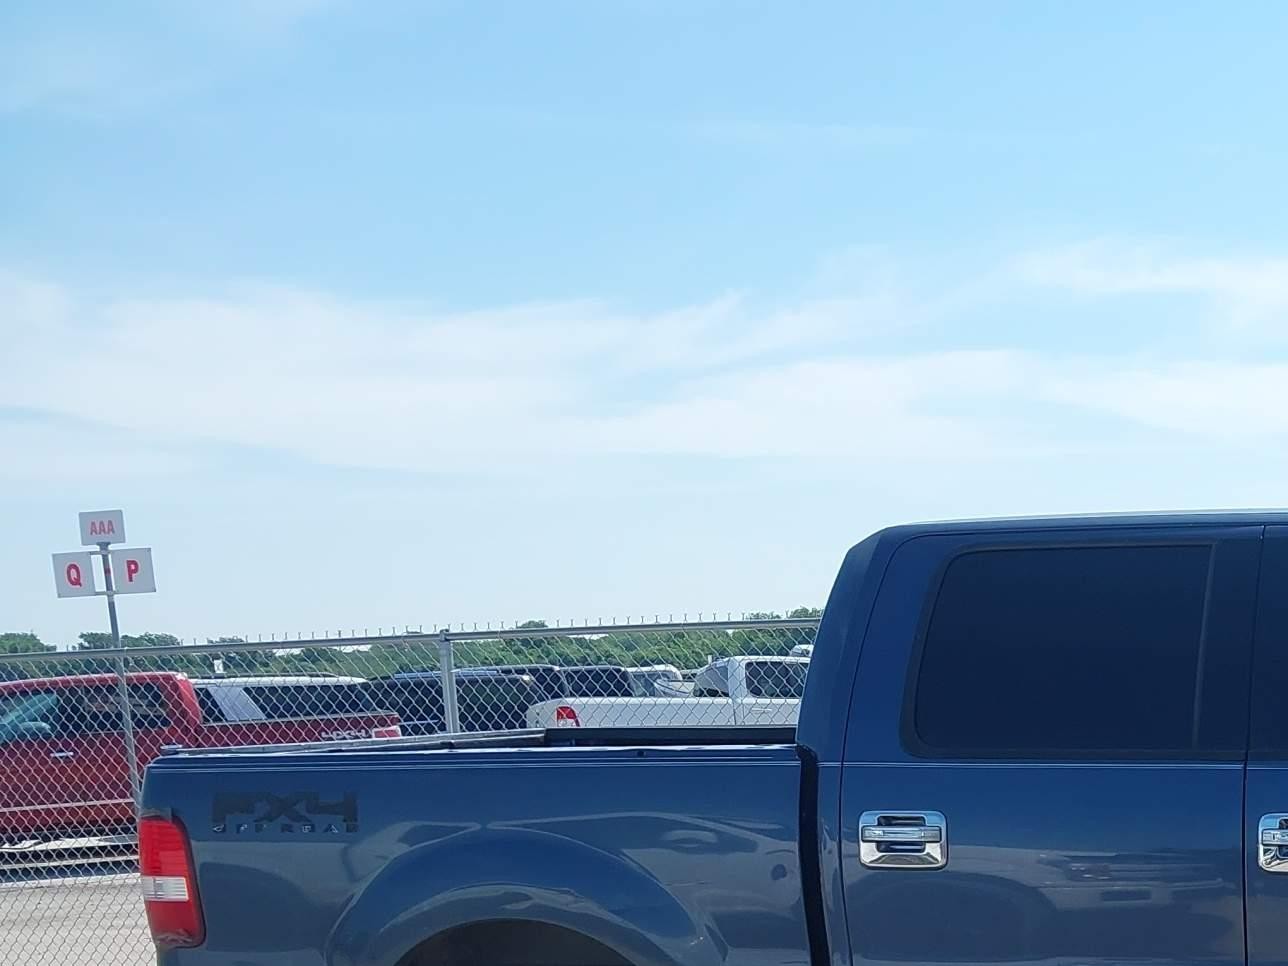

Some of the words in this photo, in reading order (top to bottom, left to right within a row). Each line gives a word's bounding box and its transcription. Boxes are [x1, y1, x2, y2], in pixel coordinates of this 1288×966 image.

[90, 519, 115, 535] AAA
[66, 563, 82, 587] Q
[126, 559, 139, 582] P
[212, 792, 358, 822] FX4
